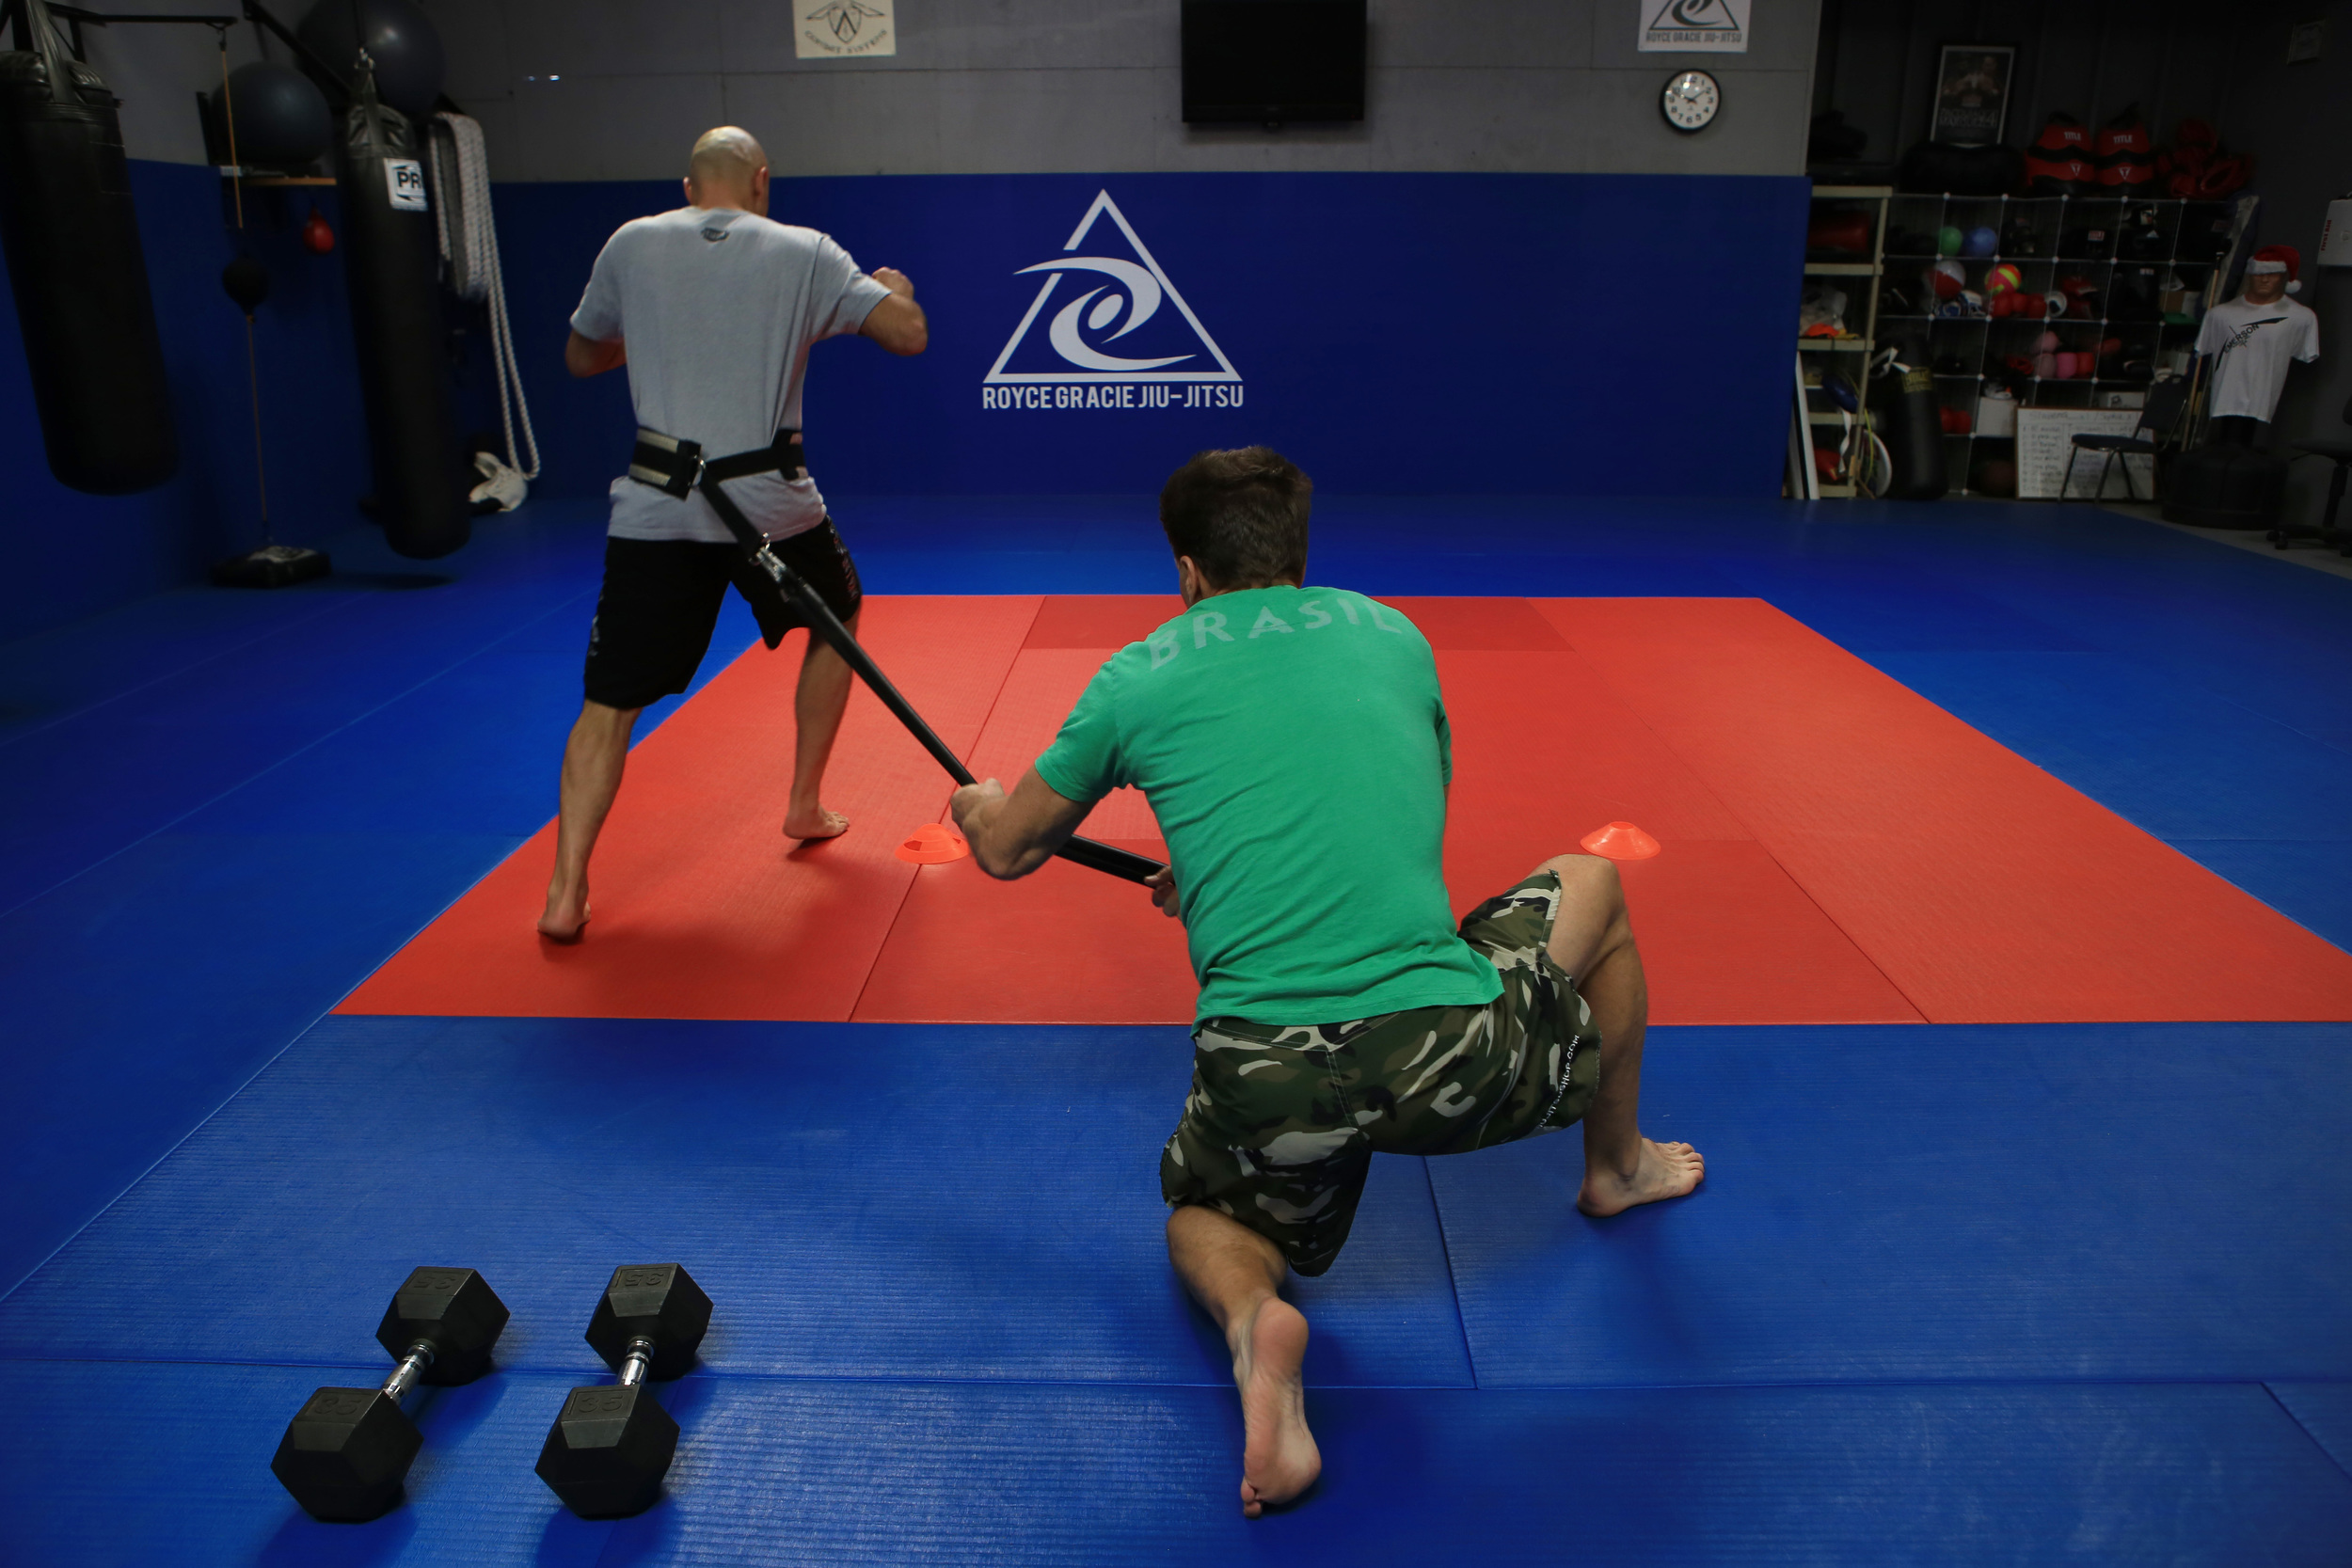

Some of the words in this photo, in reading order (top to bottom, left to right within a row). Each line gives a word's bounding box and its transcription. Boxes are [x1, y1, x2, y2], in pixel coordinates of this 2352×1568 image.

[1646, 31, 1671, 42] ROYCE
[1673, 31, 1701, 42] GRACIE
[2064, 131, 2081, 141] TITLE
[2113, 135, 2133, 144] TITLE
[982, 386, 1052, 409] ROYCE
[1055, 385, 1135, 409] GRACIE
[1137, 384, 1244, 408] JIU-JITSU
[1148, 597, 1402, 672] BRASIL
[413, 1276, 456, 1290] 35
[624, 1273, 664, 1287] 35
[578, 1395, 624, 1414] 35
